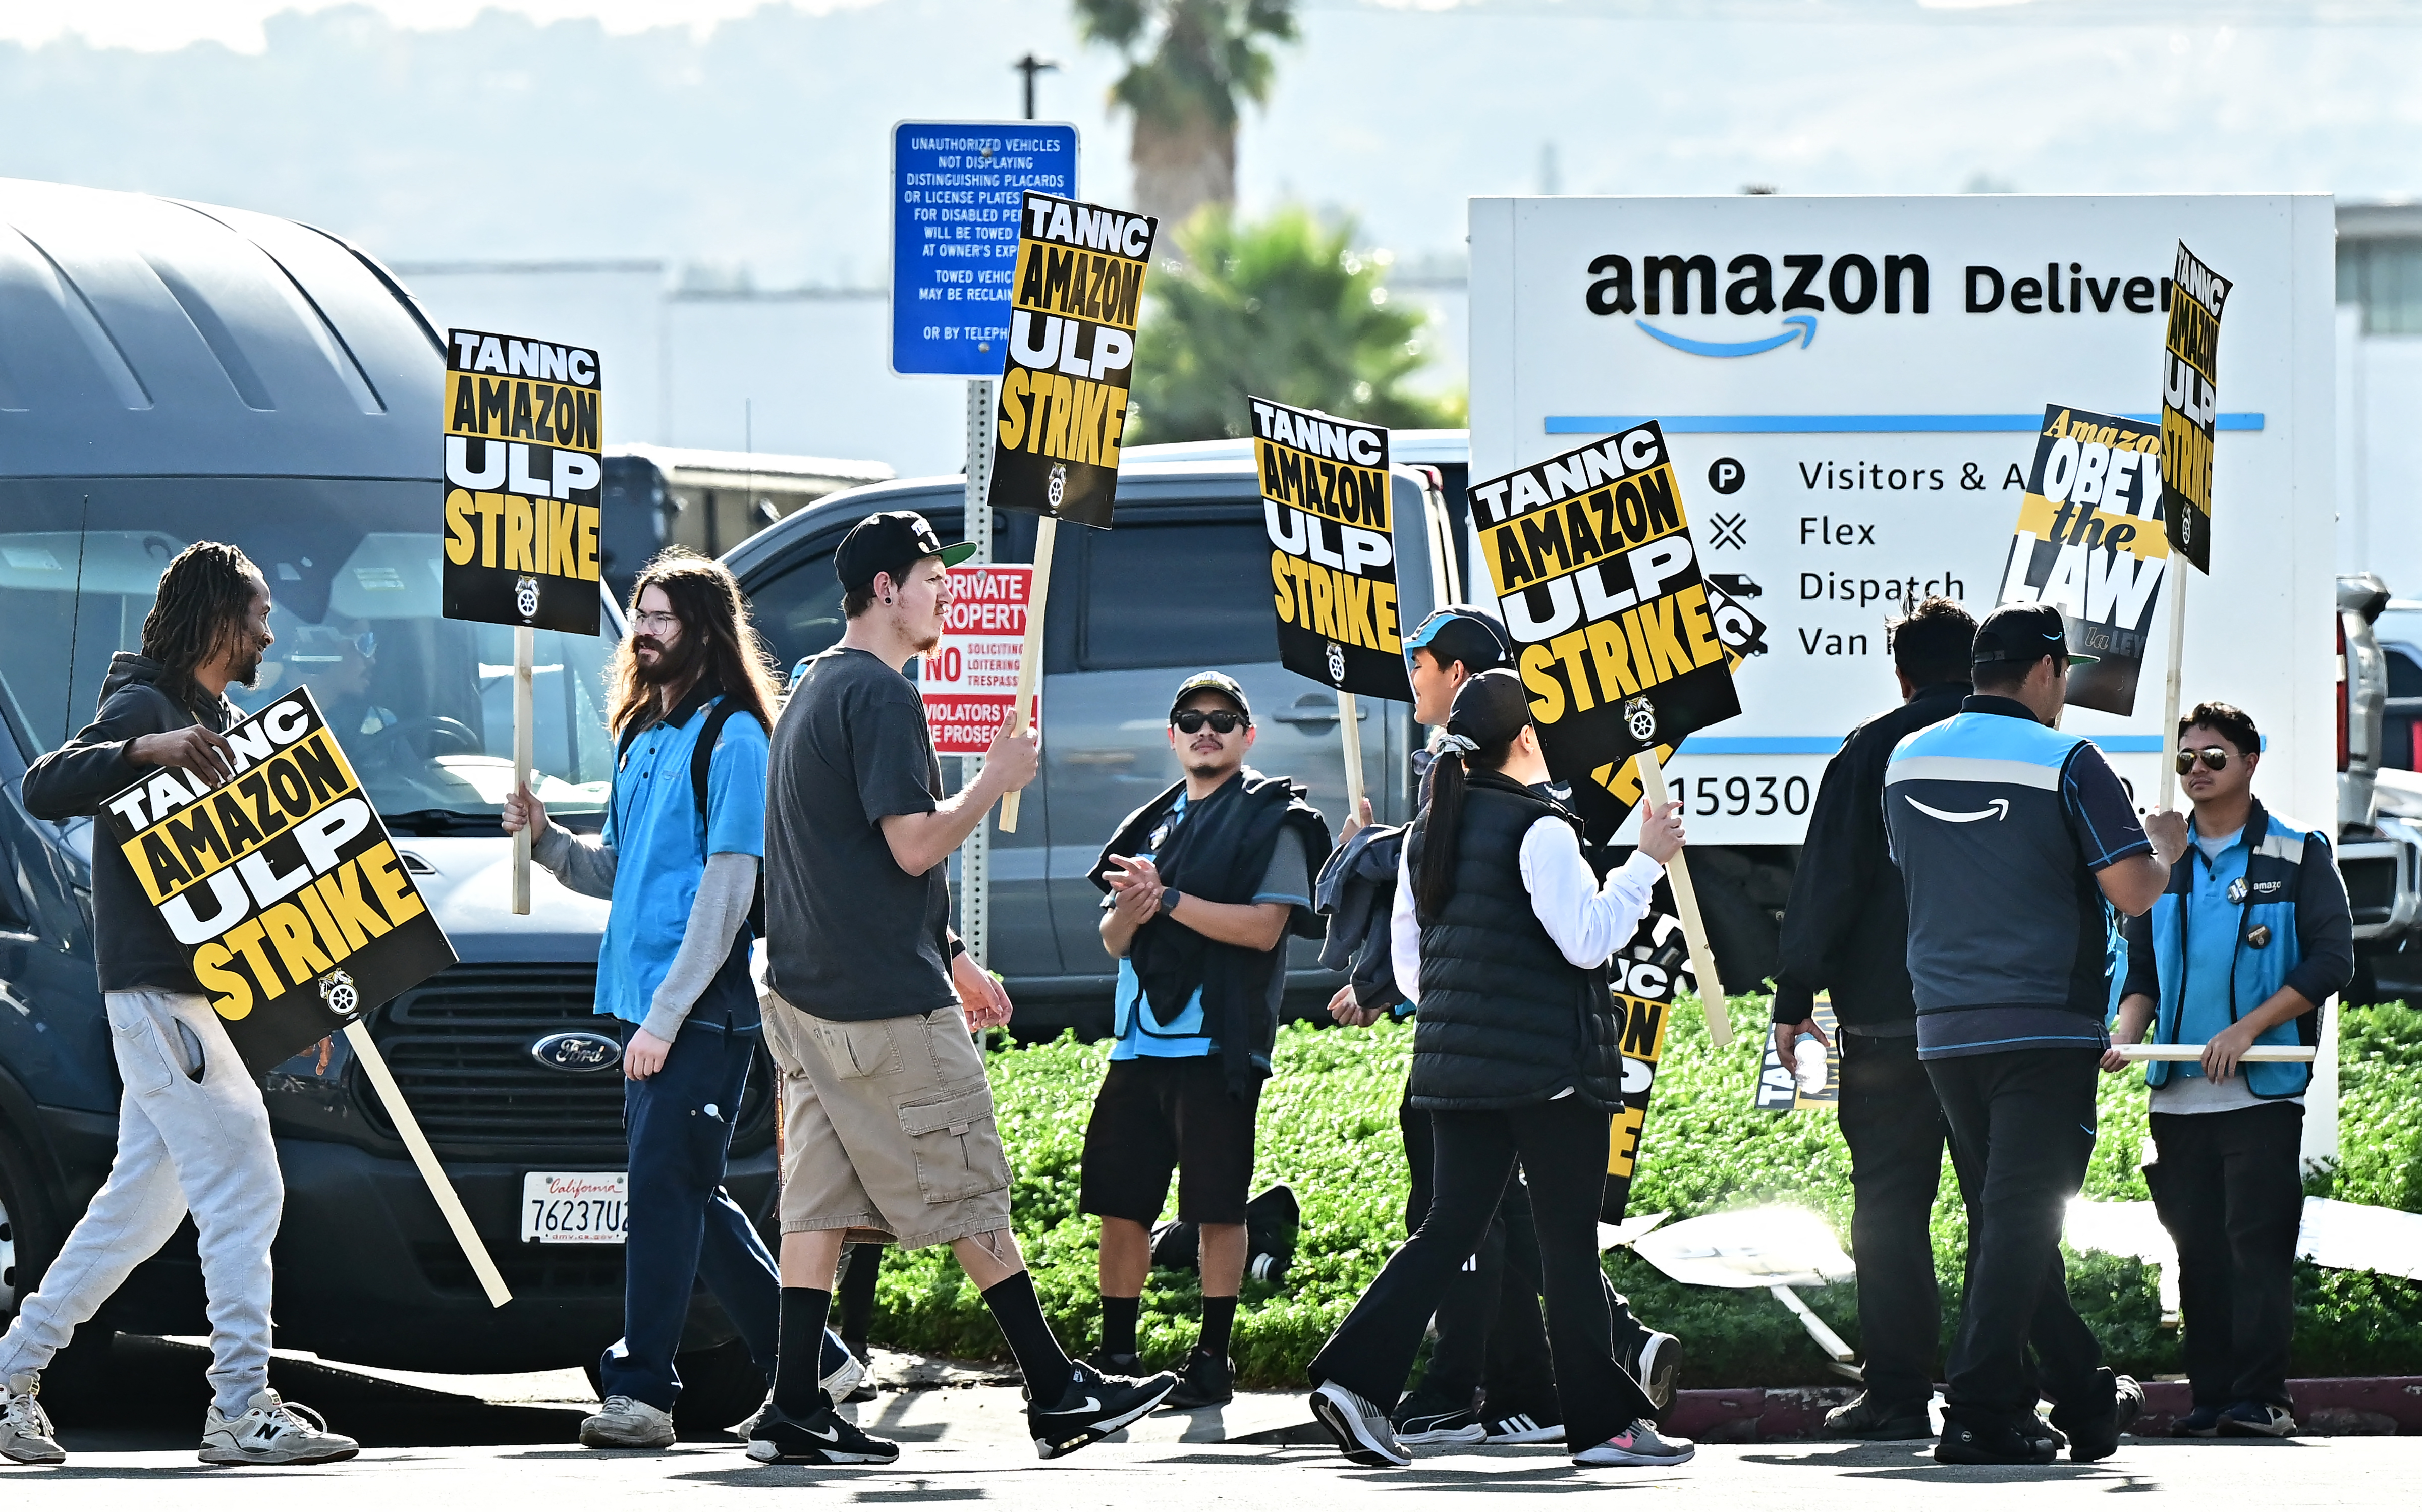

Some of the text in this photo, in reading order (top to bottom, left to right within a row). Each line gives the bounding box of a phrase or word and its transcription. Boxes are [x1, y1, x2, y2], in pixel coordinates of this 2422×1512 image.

[911, 138, 1060, 152] UNAUTHORIZED VEHICLES
[939, 156, 1033, 169] NOT DISPLAYING
[904, 191, 1020, 204] OR LICENSE PLATES
[907, 173, 1064, 187] DISTINGUISHING PLACARDS
[914, 208, 1022, 222] FOR DISABLED PE
[924, 226, 952, 239] WILL
[956, 227, 971, 239] BE
[975, 227, 1013, 240] TOWED
[1028, 198, 1148, 257] TANNC
[922, 243, 1018, 258] AT OWNER'S EXP
[934, 269, 1014, 284] TOWED VEHIC
[919, 288, 1013, 302] MAY BE RECLAI
[1020, 244, 1142, 326] AMAZON
[1585, 253, 2174, 316] amazon Deliver
[2177, 244, 2224, 317] TANNC
[455, 332, 595, 385] TANNC
[923, 326, 1009, 341] OR BY TELEPH
[1010, 310, 1133, 380] ULP
[2169, 287, 2218, 383] AMAZON
[452, 375, 597, 449] AMAZON
[2164, 349, 2215, 430] ULP
[999, 367, 1128, 469] STRIKE
[1254, 401, 1382, 466] TANNC
[2043, 409, 2161, 457] Amazo
[446, 436, 600, 500] ULP
[1263, 442, 1385, 529] AMAZON
[1475, 428, 1659, 523] TANNC
[1799, 460, 1944, 491] Visitors
[1960, 462, 1986, 491] &
[2043, 435, 2162, 522] OBEY
[2161, 404, 2214, 519] STRIKE
[445, 488, 599, 582] STRIKE
[1263, 498, 1392, 575] ULP
[1496, 468, 1681, 591] AMAZON
[1800, 515, 1876, 545] Flex
[2049, 500, 2136, 553] the
[1271, 549, 1401, 655] STRIKE
[1501, 535, 1693, 643] ULP
[1800, 571, 1963, 607] Dispatch
[2002, 529, 2166, 631] LAW
[944, 603, 1028, 630] ROPERT
[1798, 627, 1867, 655] Van
[2085, 627, 2109, 650] la
[2109, 631, 2146, 658] LEY
[925, 647, 961, 682] NO
[968, 659, 1020, 671] LOITERING
[1518, 584, 1723, 725] STRIKE
[924, 703, 1001, 722] VIOLATORS
[930, 724, 1000, 743] E PROSEC
[141, 739, 347, 897] AMAZON
[1668, 775, 1809, 816] 15930
[158, 798, 370, 945] ULP
[2253, 881, 2281, 891] amazo
[193, 840, 424, 1021] STRIKE
[556, 1039, 604, 1063] Ford
[550, 1178, 623, 1198] California
